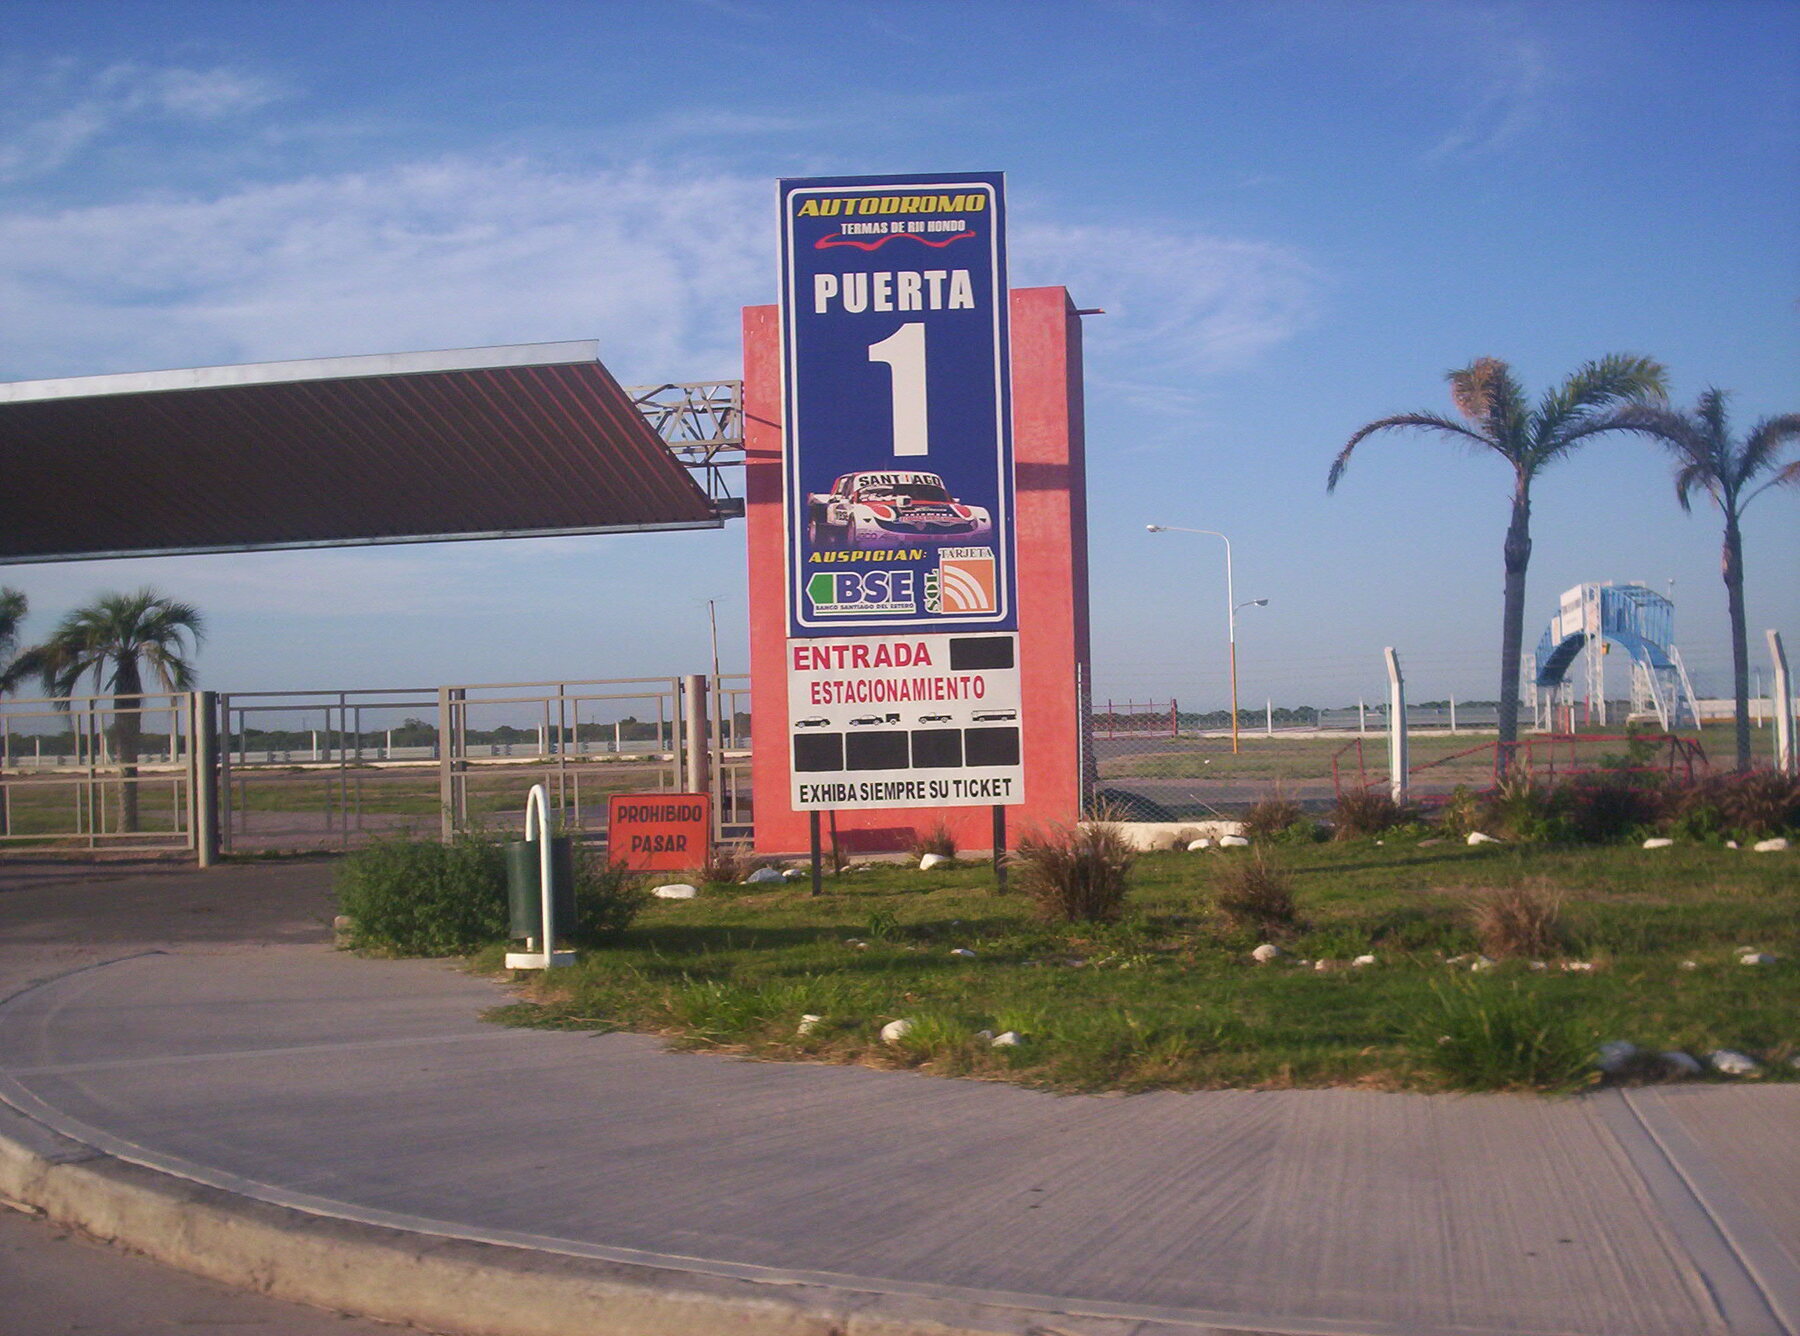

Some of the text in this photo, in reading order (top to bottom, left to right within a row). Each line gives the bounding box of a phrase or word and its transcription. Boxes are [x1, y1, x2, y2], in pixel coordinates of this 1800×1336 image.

[797, 194, 986, 217] AUTODROMO
[841, 219, 966, 235] TERMAS DE RIO HONDO
[814, 269, 975, 314] PUERTA
[868, 322, 928, 456] 1
[858, 474, 942, 487] SANTIAGO
[808, 549, 927, 563] AUSPICIAN:
[941, 548, 992, 559] TARJETA
[836, 573, 914, 604] BSE
[794, 642, 932, 671] ENTRADA
[811, 675, 985, 705] ESTACIONAMIENTO
[800, 778, 1012, 803] EXHIBA SIEMPRE SU TICKET
[617, 804, 703, 824] PROHIBIDO
[631, 834, 688, 853] PASAR
